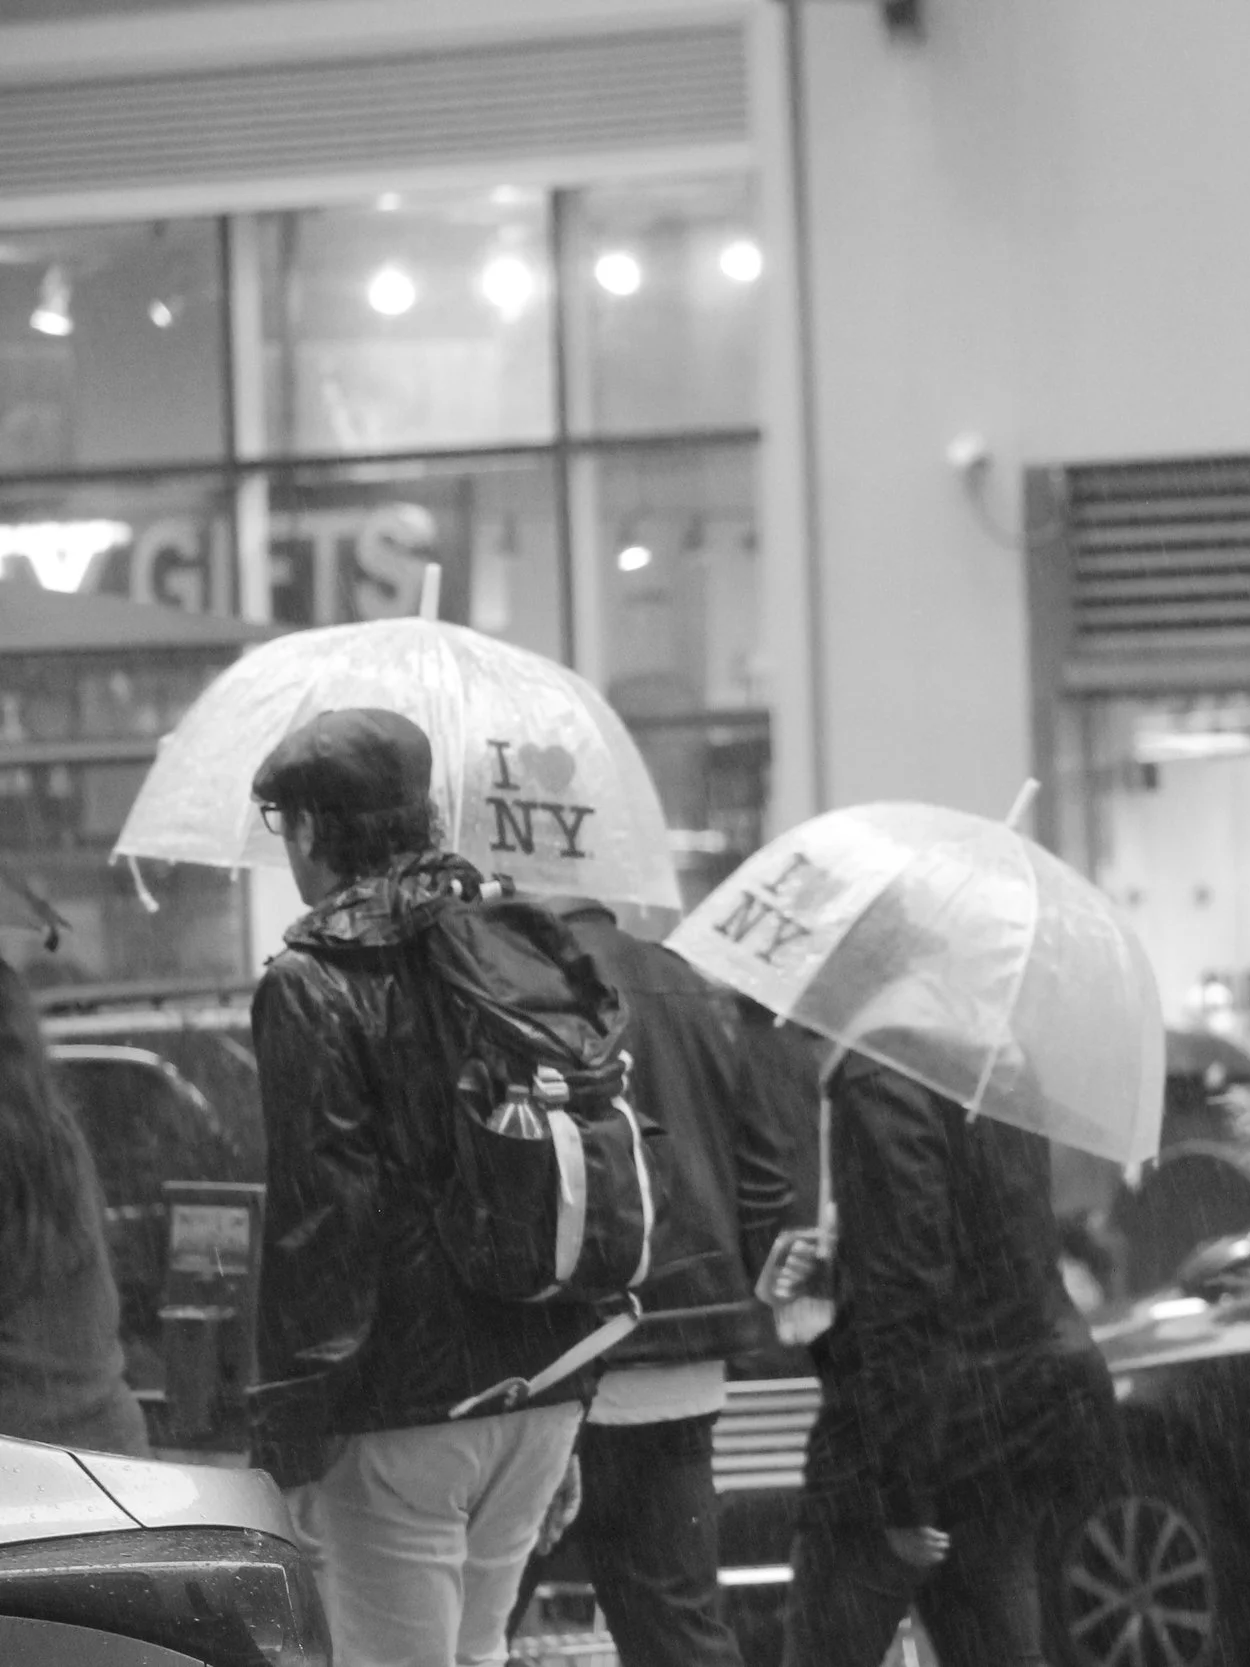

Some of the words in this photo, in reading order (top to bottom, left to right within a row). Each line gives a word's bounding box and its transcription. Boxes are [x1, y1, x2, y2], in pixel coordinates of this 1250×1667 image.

[487, 739, 520, 790] I
[486, 798, 595, 858] NY
[763, 852, 810, 895] I
[714, 890, 811, 963] NY
